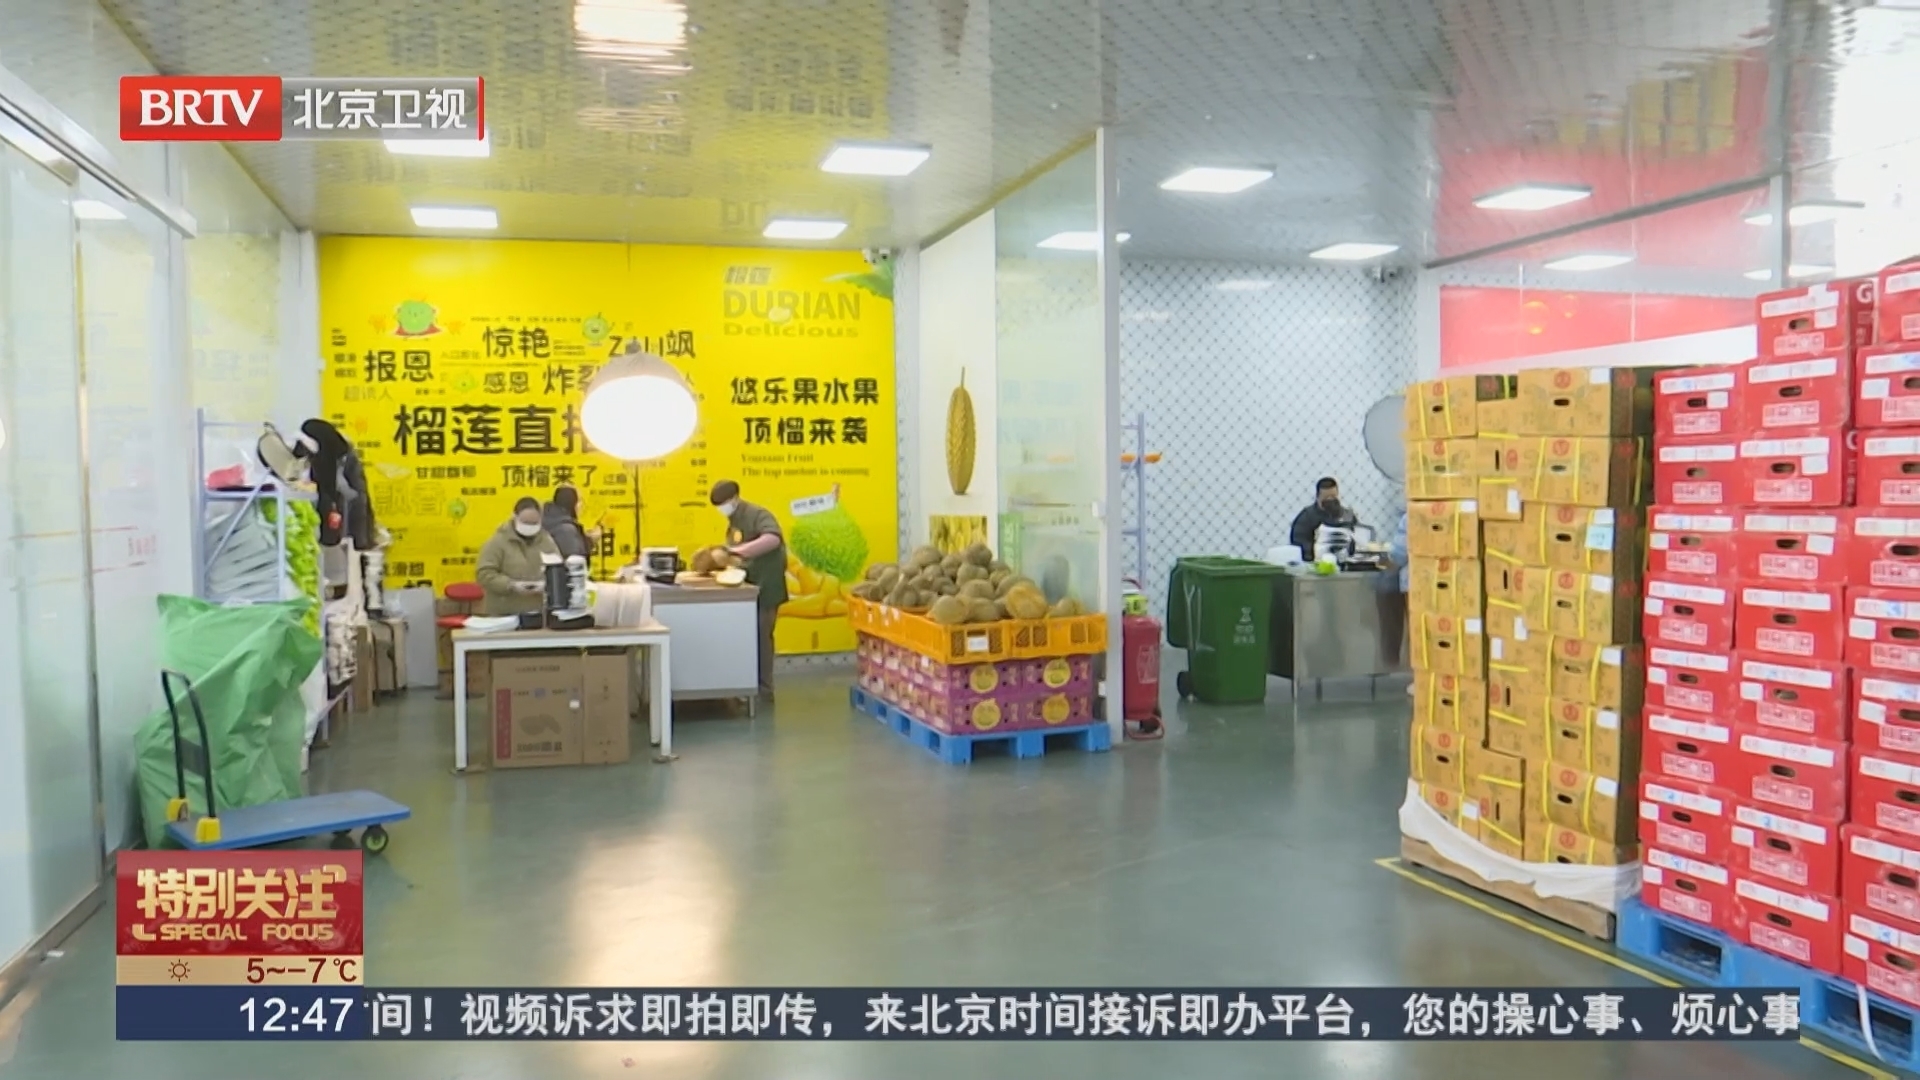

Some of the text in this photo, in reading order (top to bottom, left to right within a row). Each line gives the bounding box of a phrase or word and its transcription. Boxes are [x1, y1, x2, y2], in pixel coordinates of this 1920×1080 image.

[724, 290, 860, 320] DURIAN
[482, 326, 551, 358] 惊艳
[724, 322, 859, 338] Delicious
[364, 349, 434, 382] 报恩
[483, 371, 530, 394] 感恩
[730, 377, 879, 405] 悠乐果水果
[743, 416, 868, 445] 顶榴来袭
[501, 464, 598, 488] 顶榴来了
